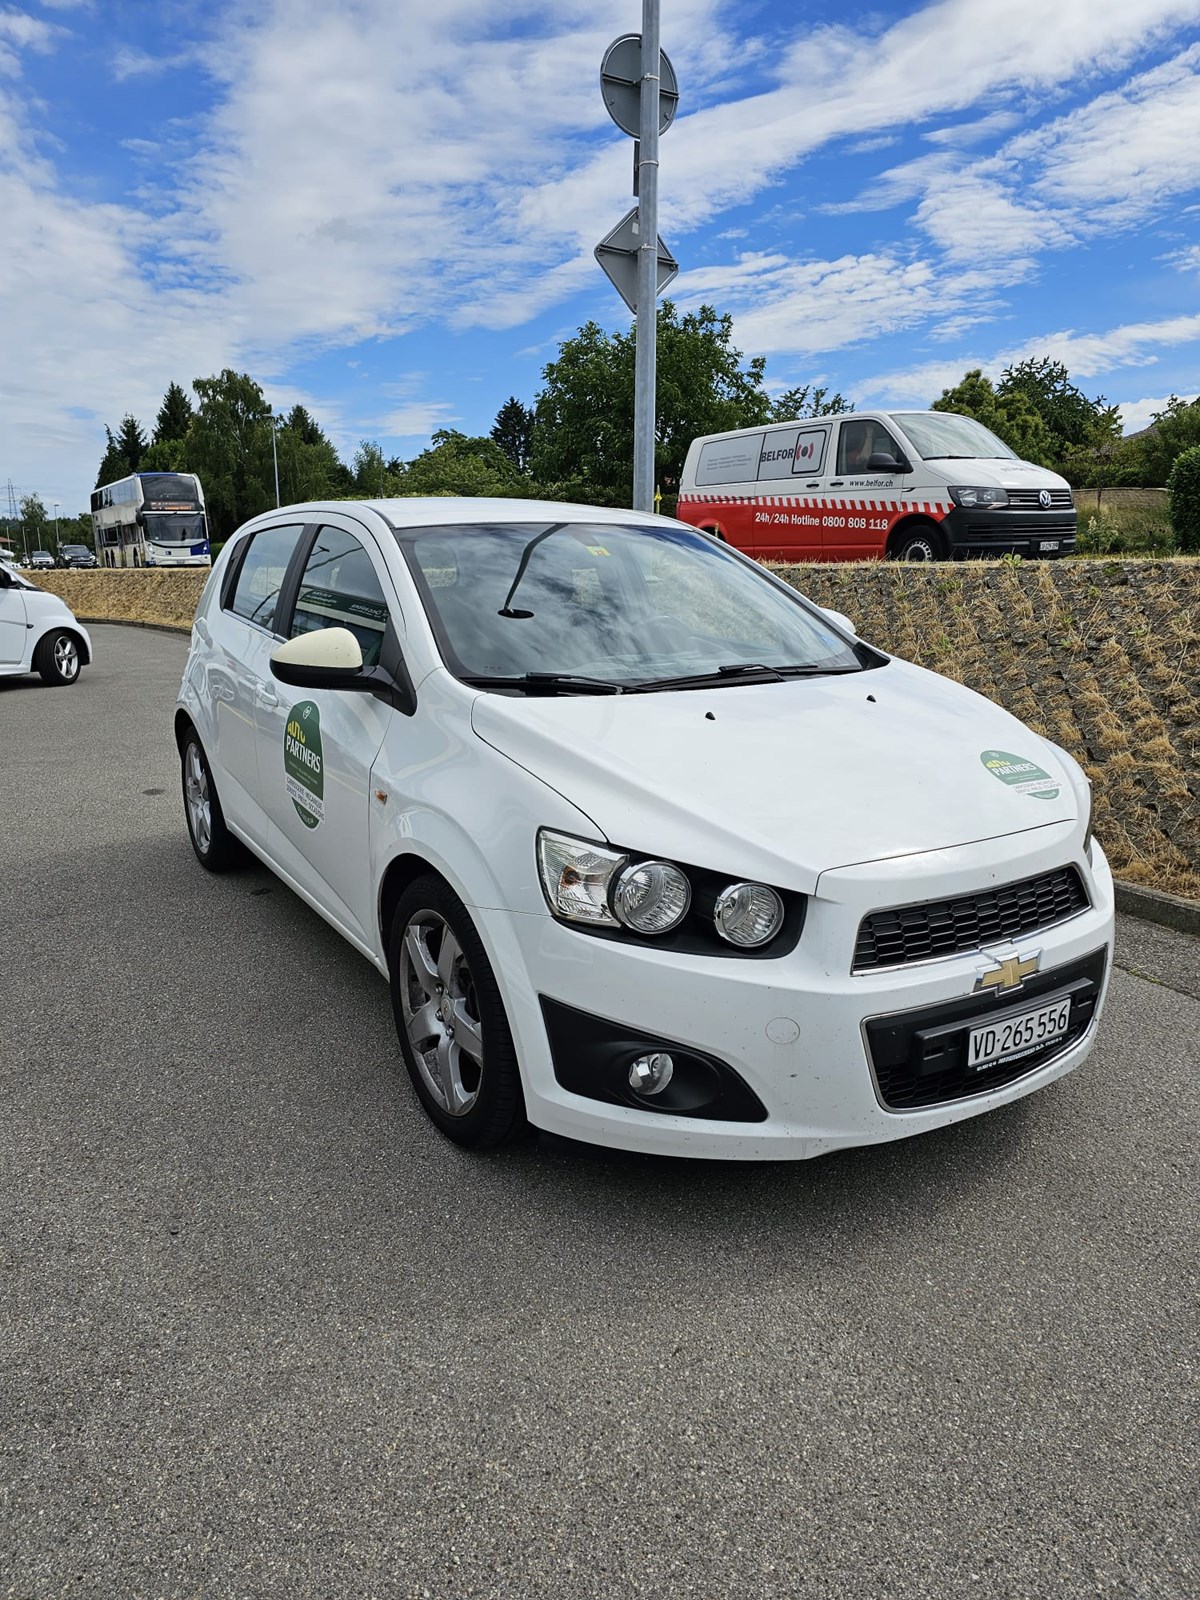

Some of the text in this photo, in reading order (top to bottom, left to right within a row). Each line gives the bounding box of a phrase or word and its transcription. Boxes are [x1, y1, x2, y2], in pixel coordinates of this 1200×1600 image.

[761, 448, 794, 462] BELFOR
[849, 480, 894, 488] www.belfor.ch
[755, 512, 889, 530] 24h/24h Hotline 0800 808 118
[286, 735, 321, 773] PARTNERS
[991, 763, 1037, 776] PARTNERS
